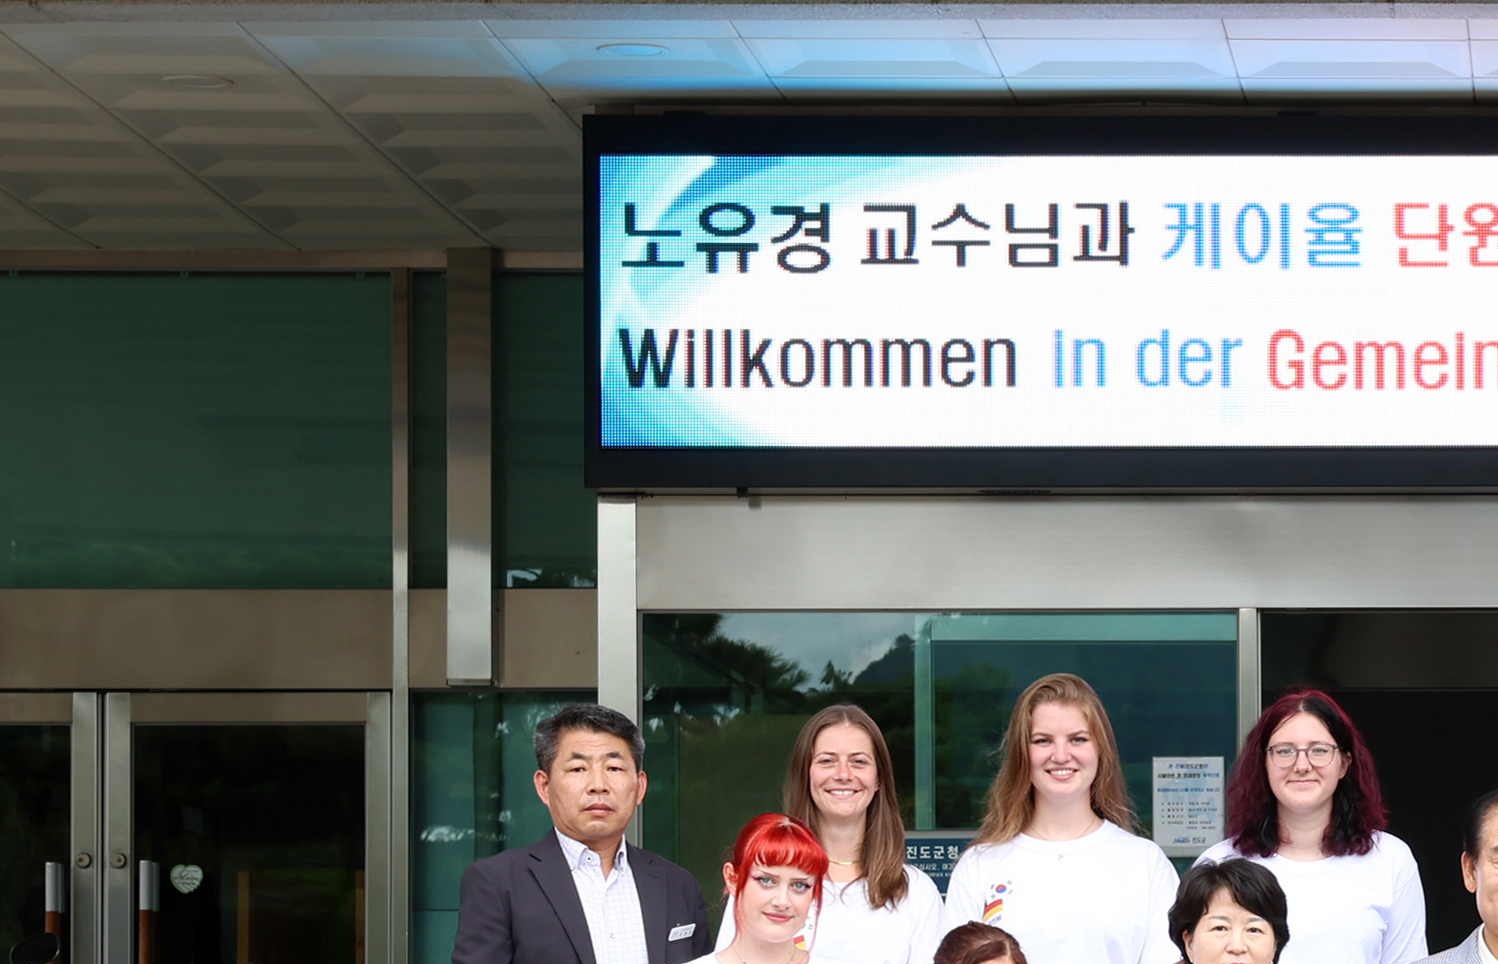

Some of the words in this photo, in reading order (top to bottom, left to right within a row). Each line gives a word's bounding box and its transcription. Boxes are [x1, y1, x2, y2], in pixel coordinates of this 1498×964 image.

[621, 201, 830, 274] 노유경
[860, 201, 1134, 269] 교수님과
[1163, 202, 1362, 270] 케이율
[618, 328, 1016, 388] Willkommen
[1055, 329, 1106, 388] in
[1136, 328, 1242, 388] der
[906, 845, 959, 860] 진도군청
